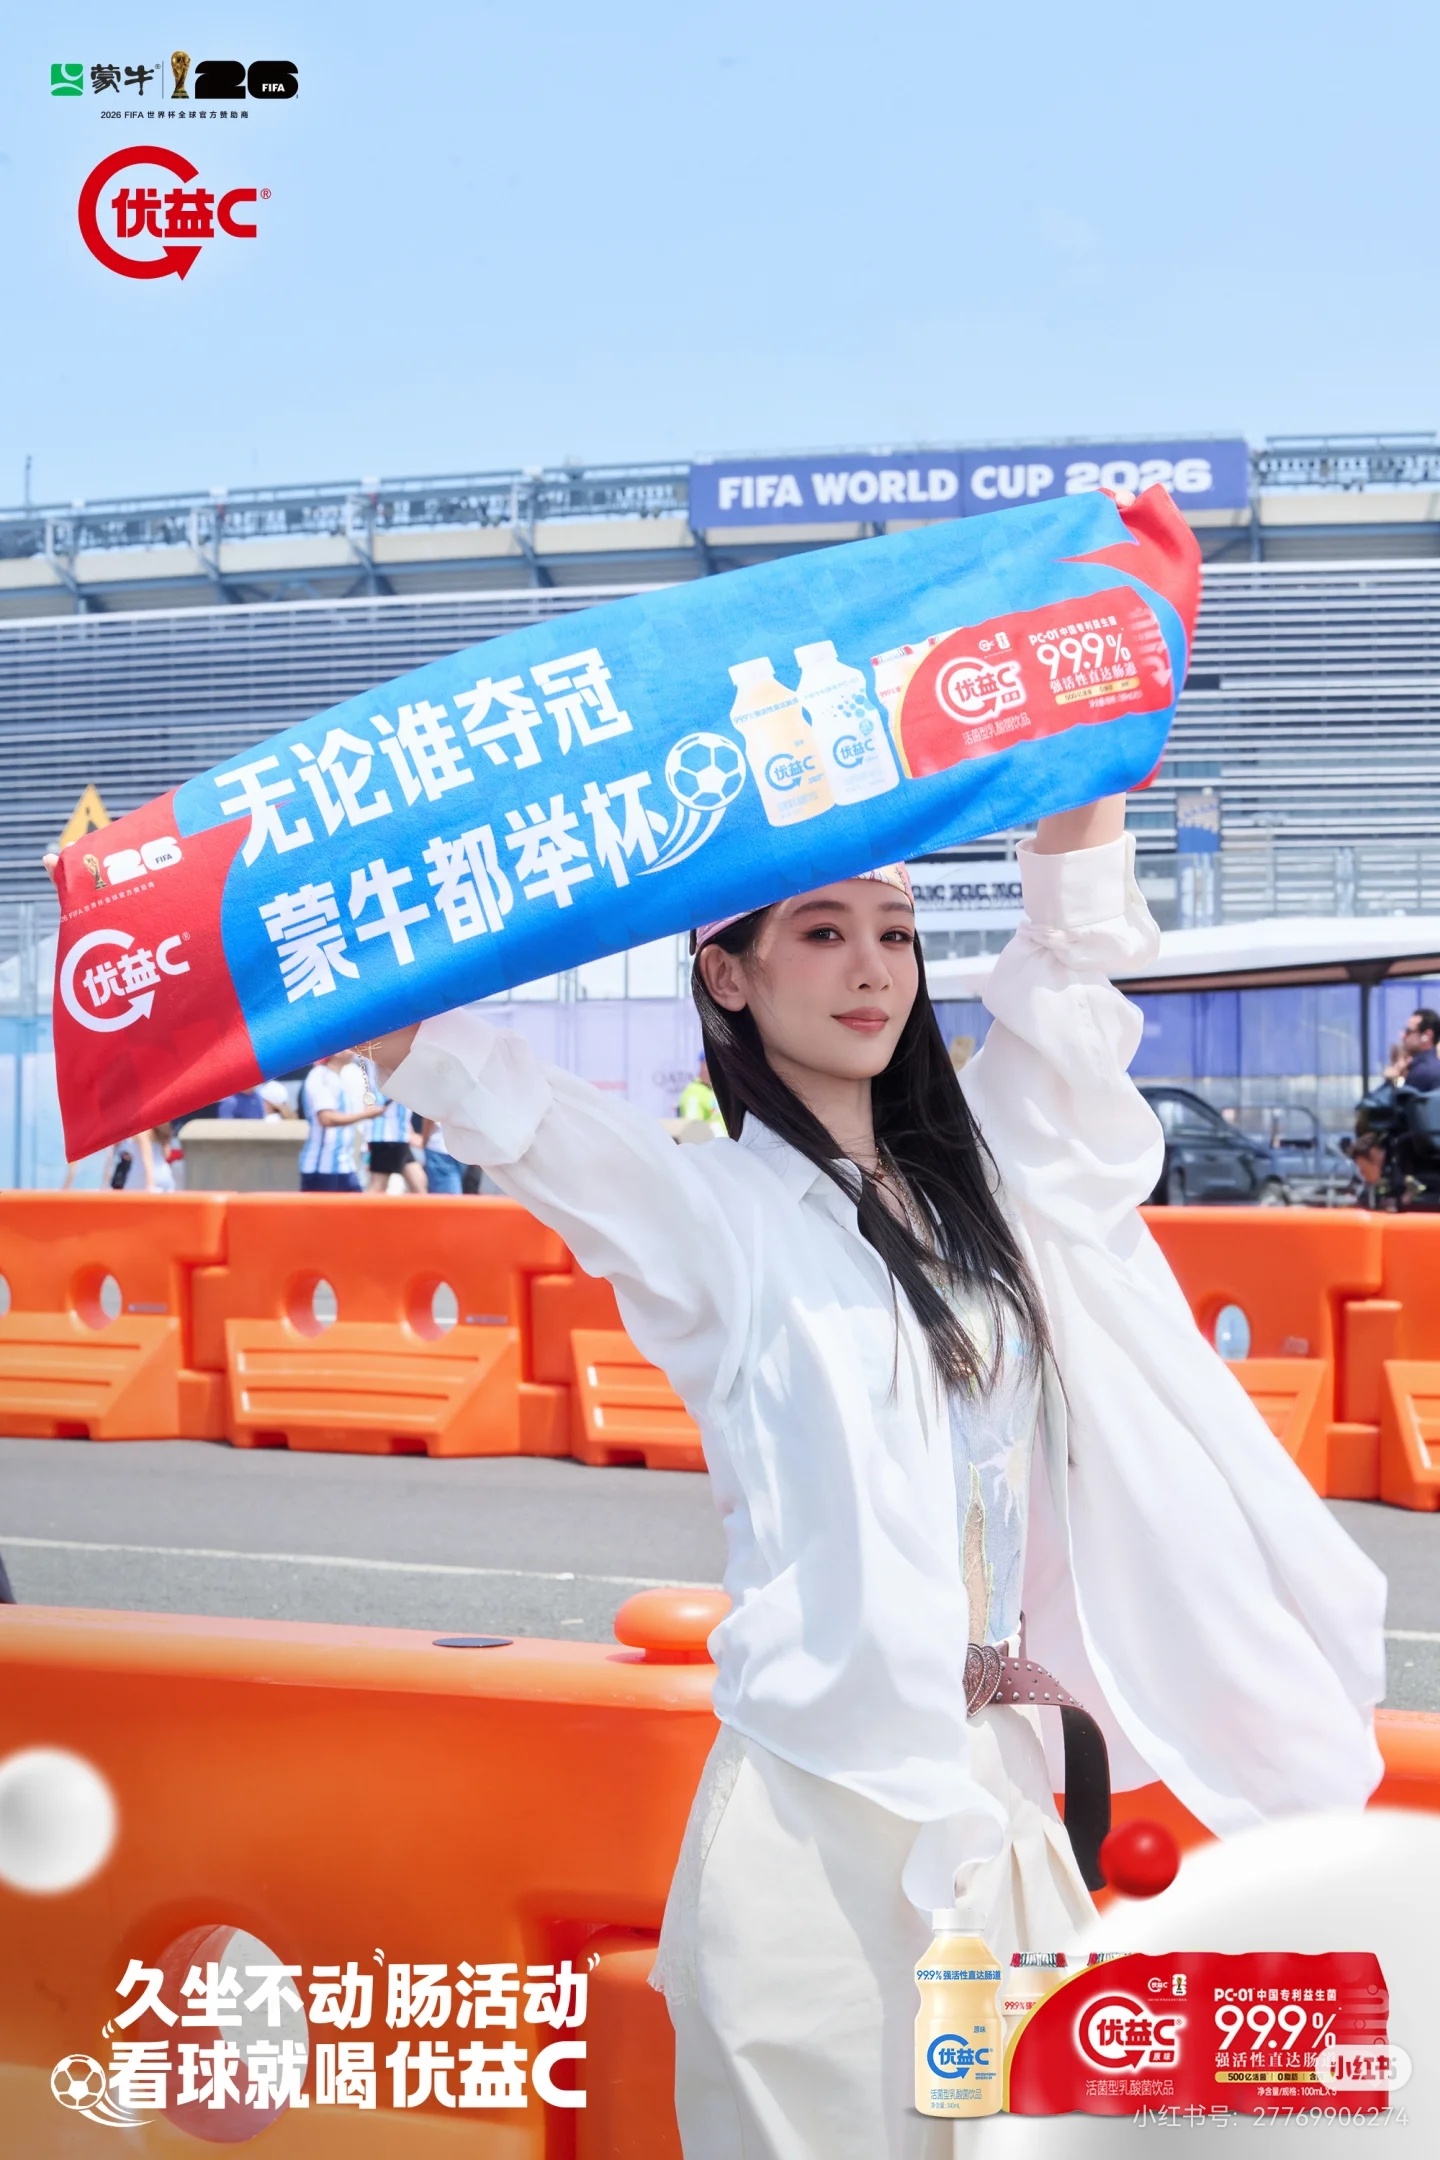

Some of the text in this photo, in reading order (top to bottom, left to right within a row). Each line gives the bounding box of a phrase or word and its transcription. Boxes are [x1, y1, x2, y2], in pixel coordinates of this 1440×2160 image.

[718, 458, 1214, 509] FIFA WORLD CUP 2026
[1036, 632, 1132, 680] 99.9%
[955, 666, 1017, 703] 优益C
[213, 647, 634, 868] 无论谁夺冠
[840, 738, 876, 760] 优益C
[773, 755, 816, 782] 优益C
[103, 835, 183, 886] 26
[154, 853, 173, 864] FIFA
[259, 771, 668, 1005] 蒙牛都举杯
[69, 909, 83, 919] FIFA
[82, 934, 191, 1008] 优益C
[1214, 1987, 1337, 2002] PC-01 中国专利益生菌
[1096, 2018, 1175, 2047] 优益C
[1214, 2004, 1337, 2051] 99.9%
[938, 2047, 990, 2066] 优益C
[1152, 2051, 1172, 2061] 原味
[1085, 2079, 1174, 2097] 活菌型乳酸菌饮品
